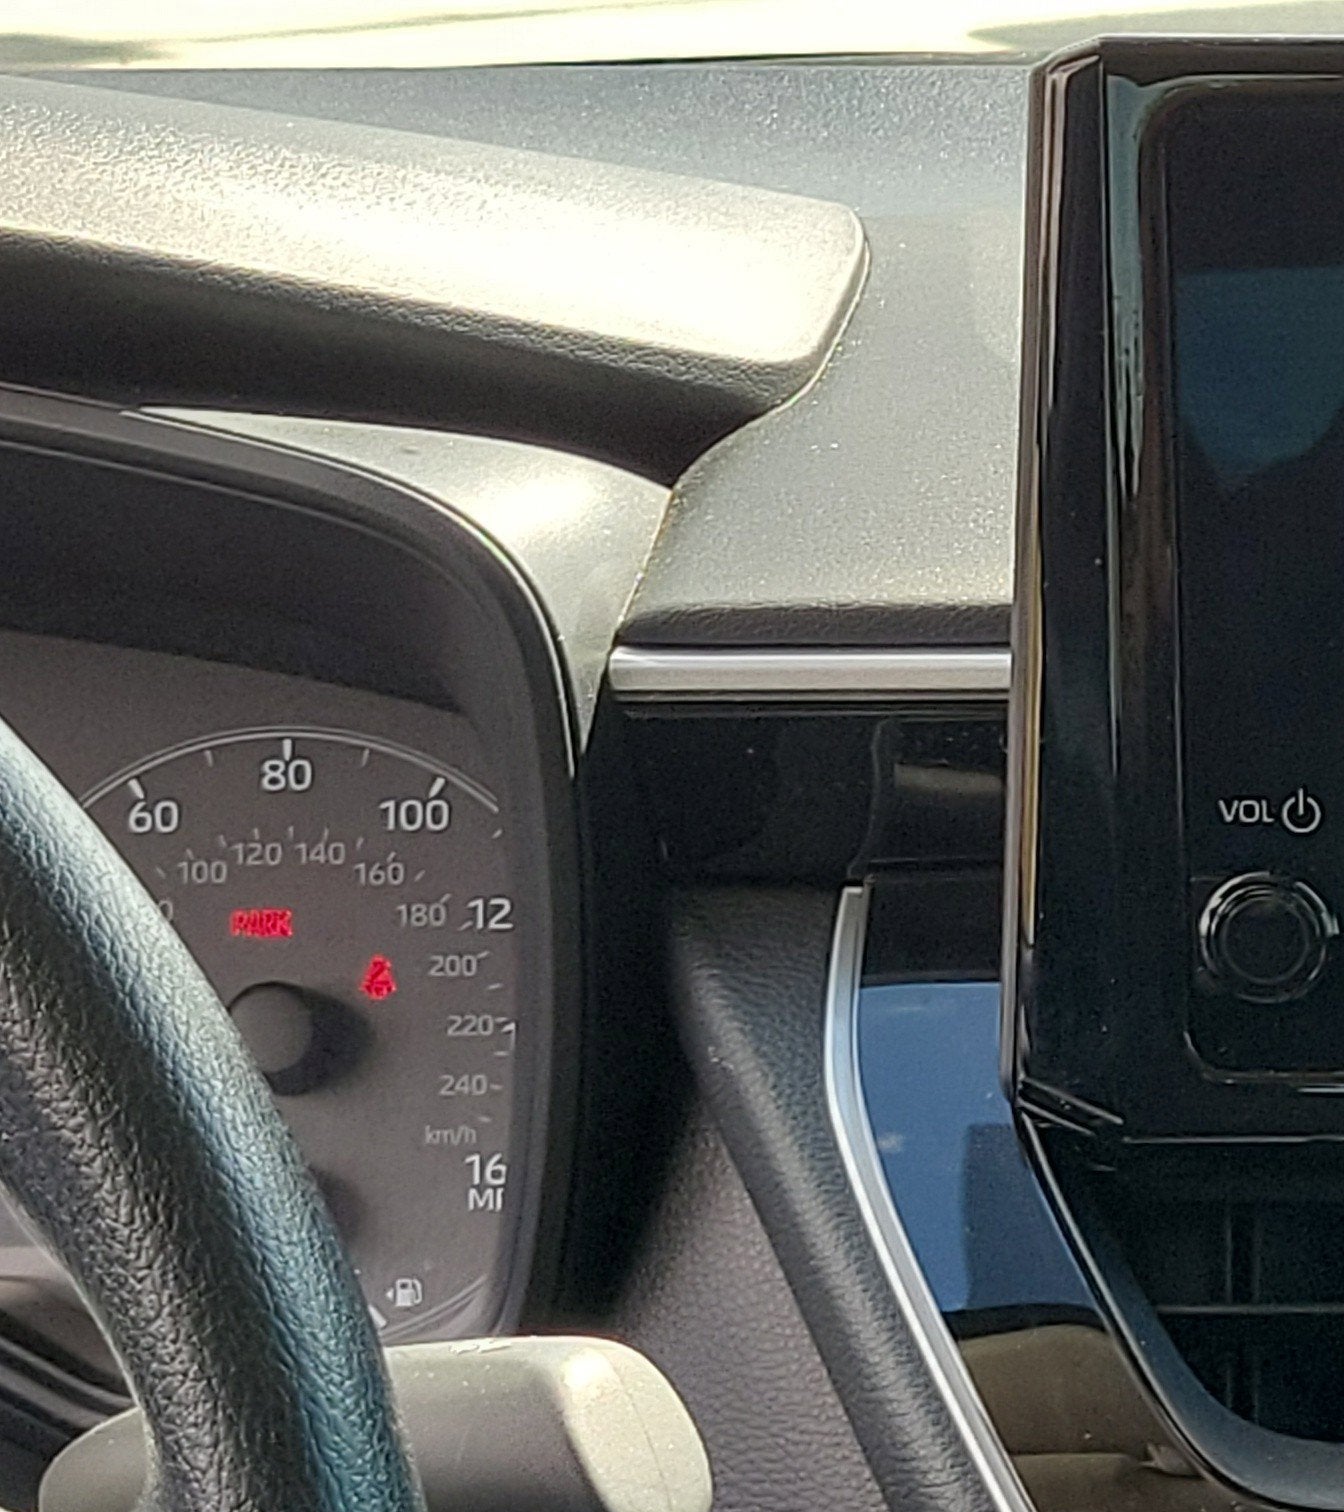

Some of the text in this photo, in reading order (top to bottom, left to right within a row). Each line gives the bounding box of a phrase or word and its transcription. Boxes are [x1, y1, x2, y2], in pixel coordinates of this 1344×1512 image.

[261, 759, 313, 792] 80
[128, 801, 180, 834] 60
[378, 799, 450, 831] 100
[1217, 799, 1275, 823] VOL
[230, 842, 283, 867] 120
[294, 842, 347, 866] 140
[177, 860, 228, 884] 100
[353, 860, 405, 886] 160
[230, 909, 293, 937] PARK
[396, 903, 447, 927] 180
[428, 954, 478, 977] 200
[447, 1014, 494, 1036] 220
[439, 1074, 488, 1096] 240
[424, 1125, 477, 1146] km/h
